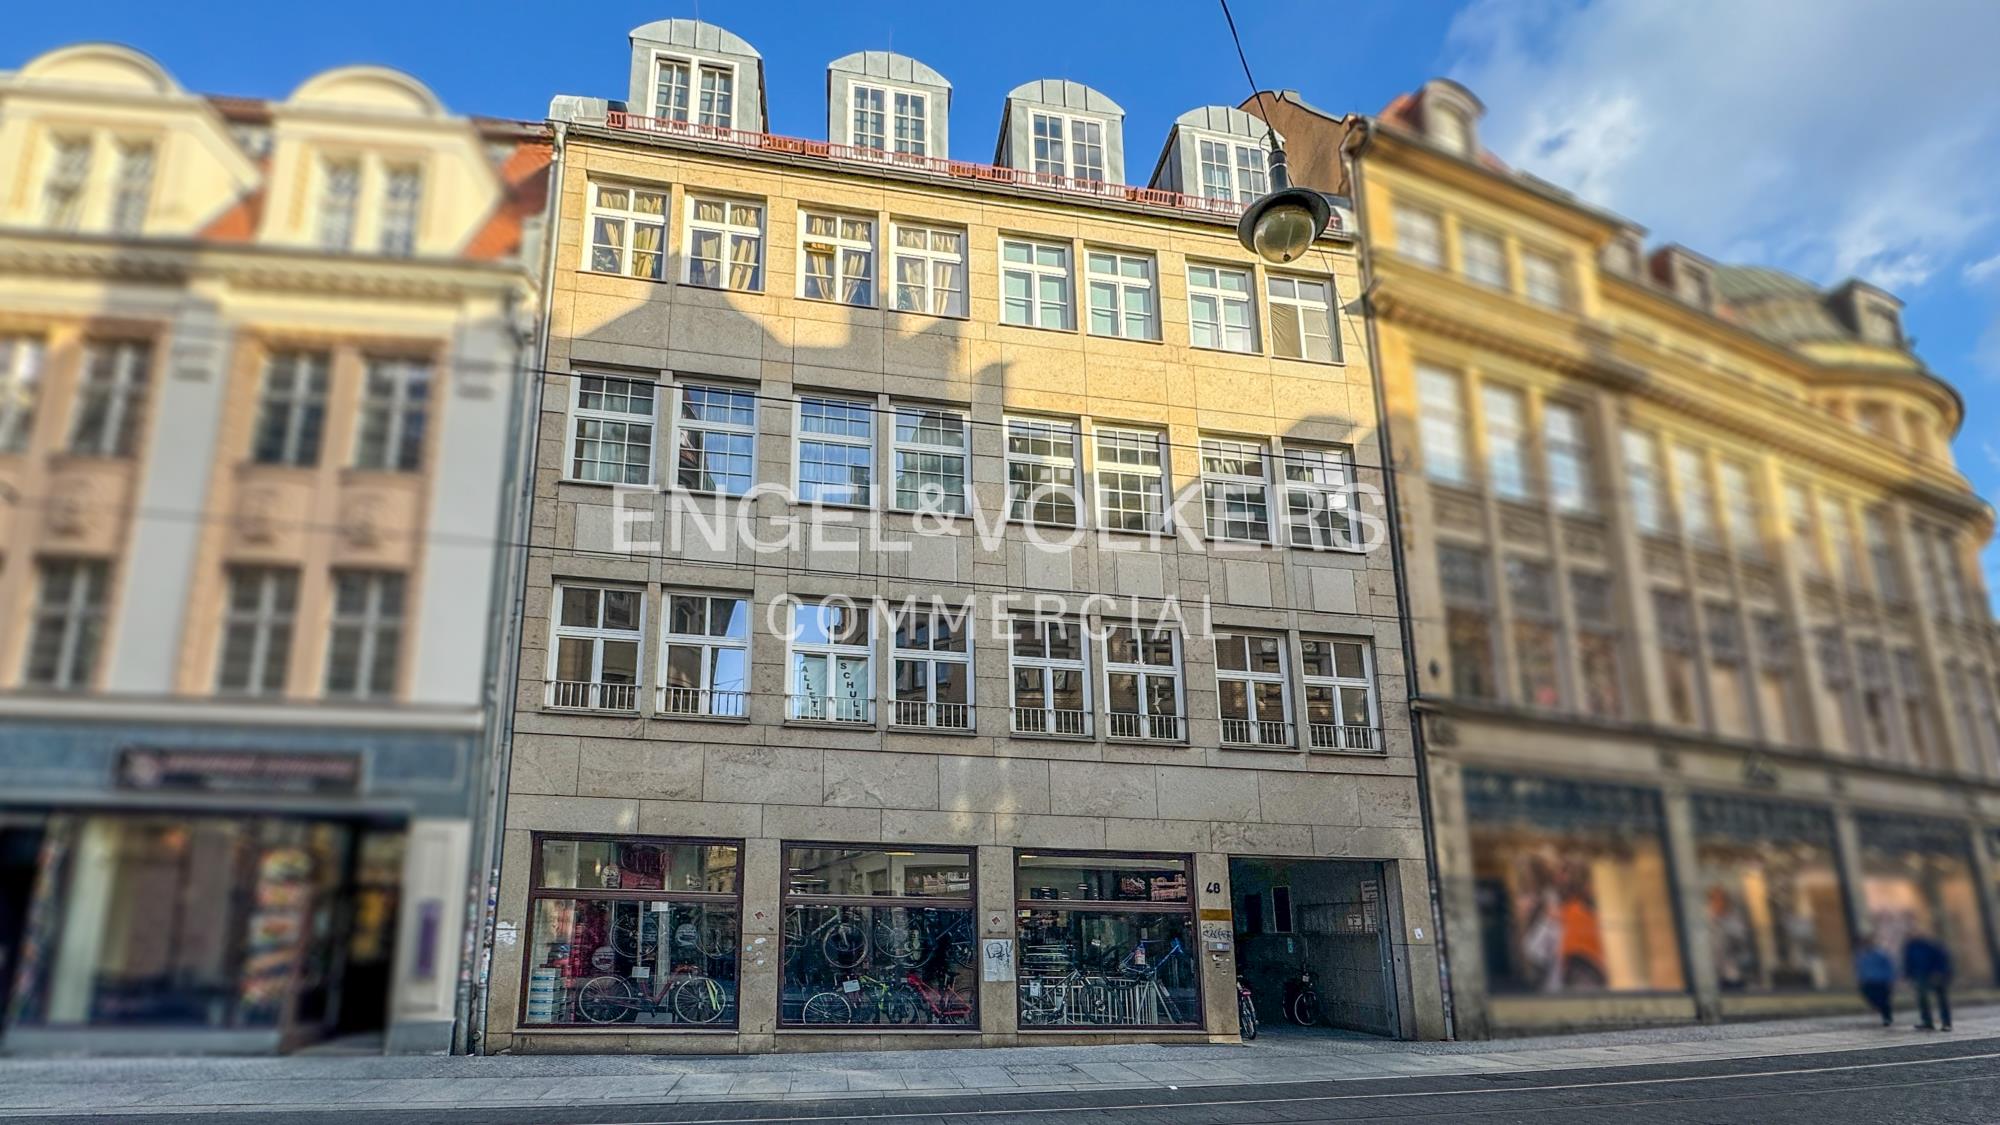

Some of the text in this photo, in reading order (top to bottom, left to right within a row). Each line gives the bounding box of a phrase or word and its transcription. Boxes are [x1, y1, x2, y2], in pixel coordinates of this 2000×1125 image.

[800, 657, 821, 716] ALLETT
[840, 662, 862, 717] SCHULE
[1206, 882, 1221, 894] 48
